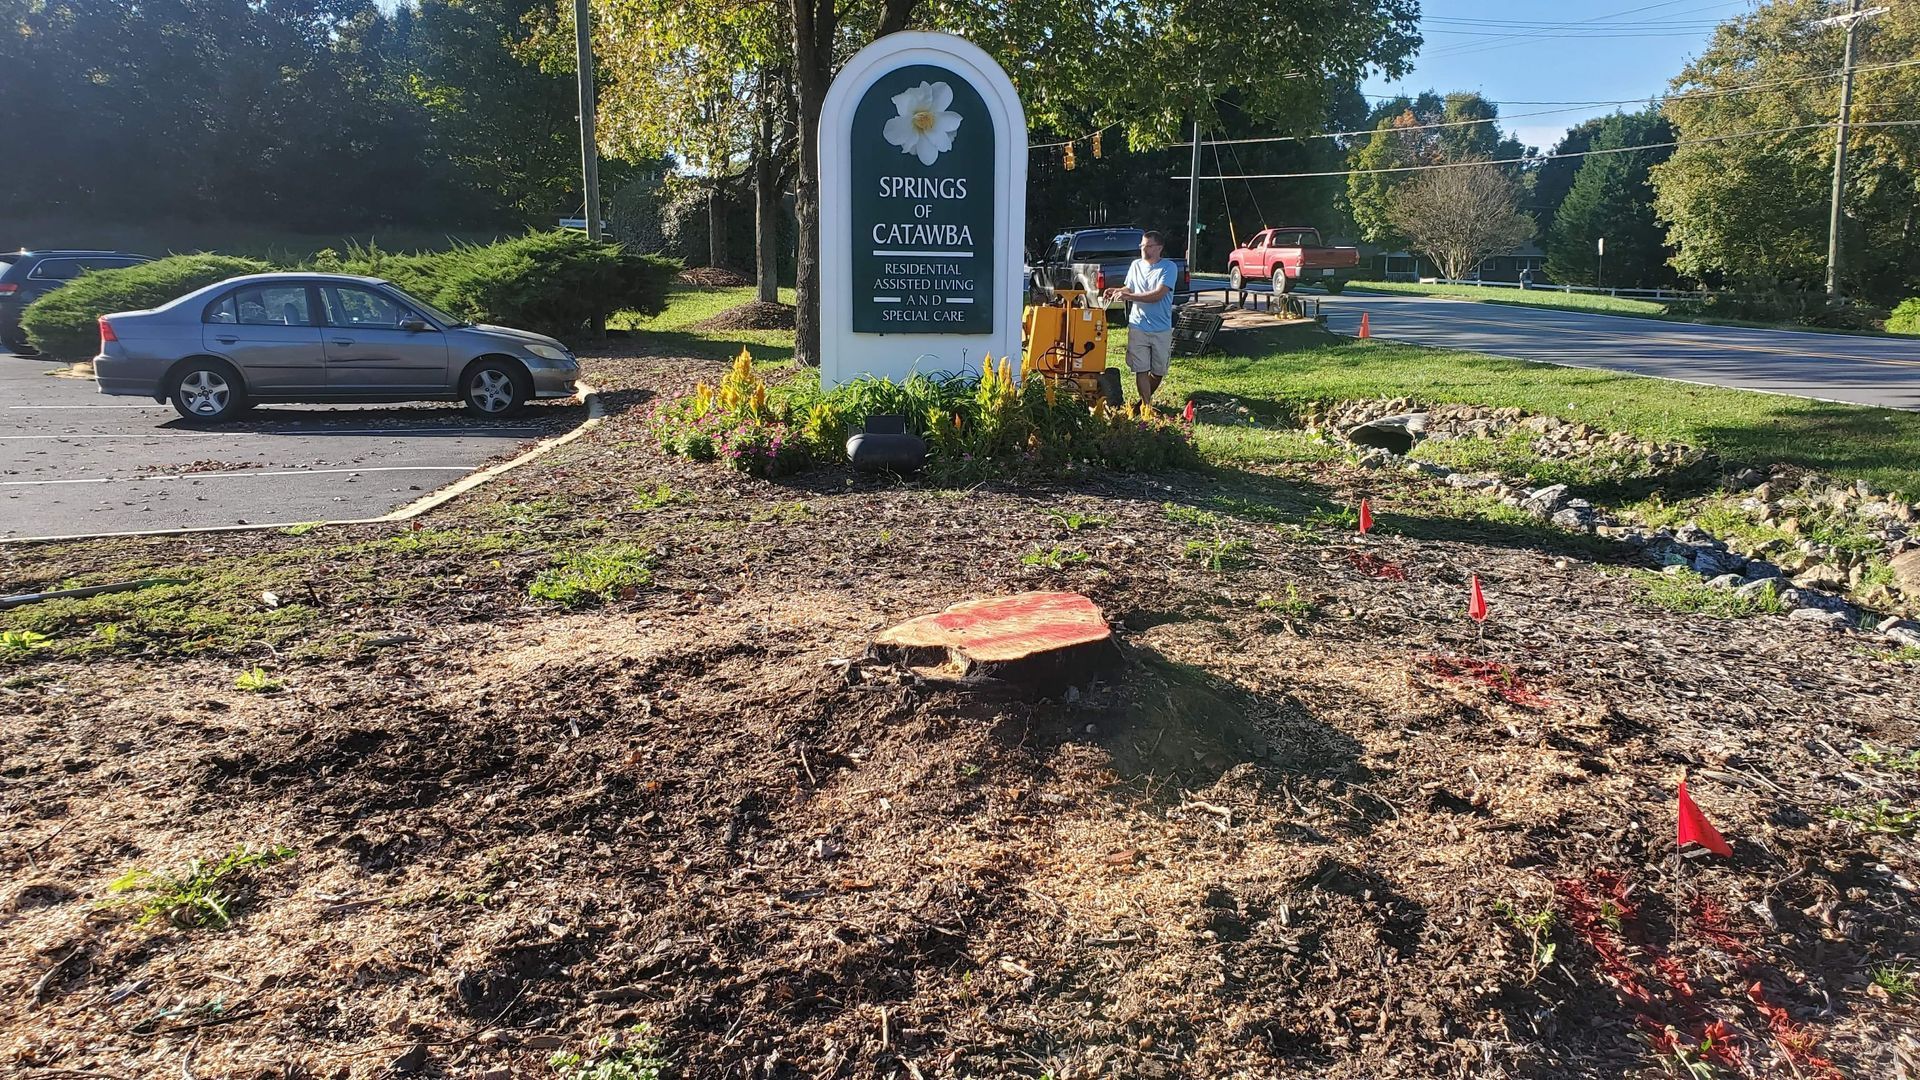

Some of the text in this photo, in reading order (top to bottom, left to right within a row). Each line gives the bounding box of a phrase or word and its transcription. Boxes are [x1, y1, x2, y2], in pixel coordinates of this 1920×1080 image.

[879, 176, 967, 199] SPRINGS
[914, 204, 933, 218] OF
[872, 223, 974, 246] CATAWBA
[885, 263, 962, 275] RESIDENTIAL
[873, 278, 974, 291] ASSISTED LIVING
[882, 310, 965, 322] SPECIAL CARE
